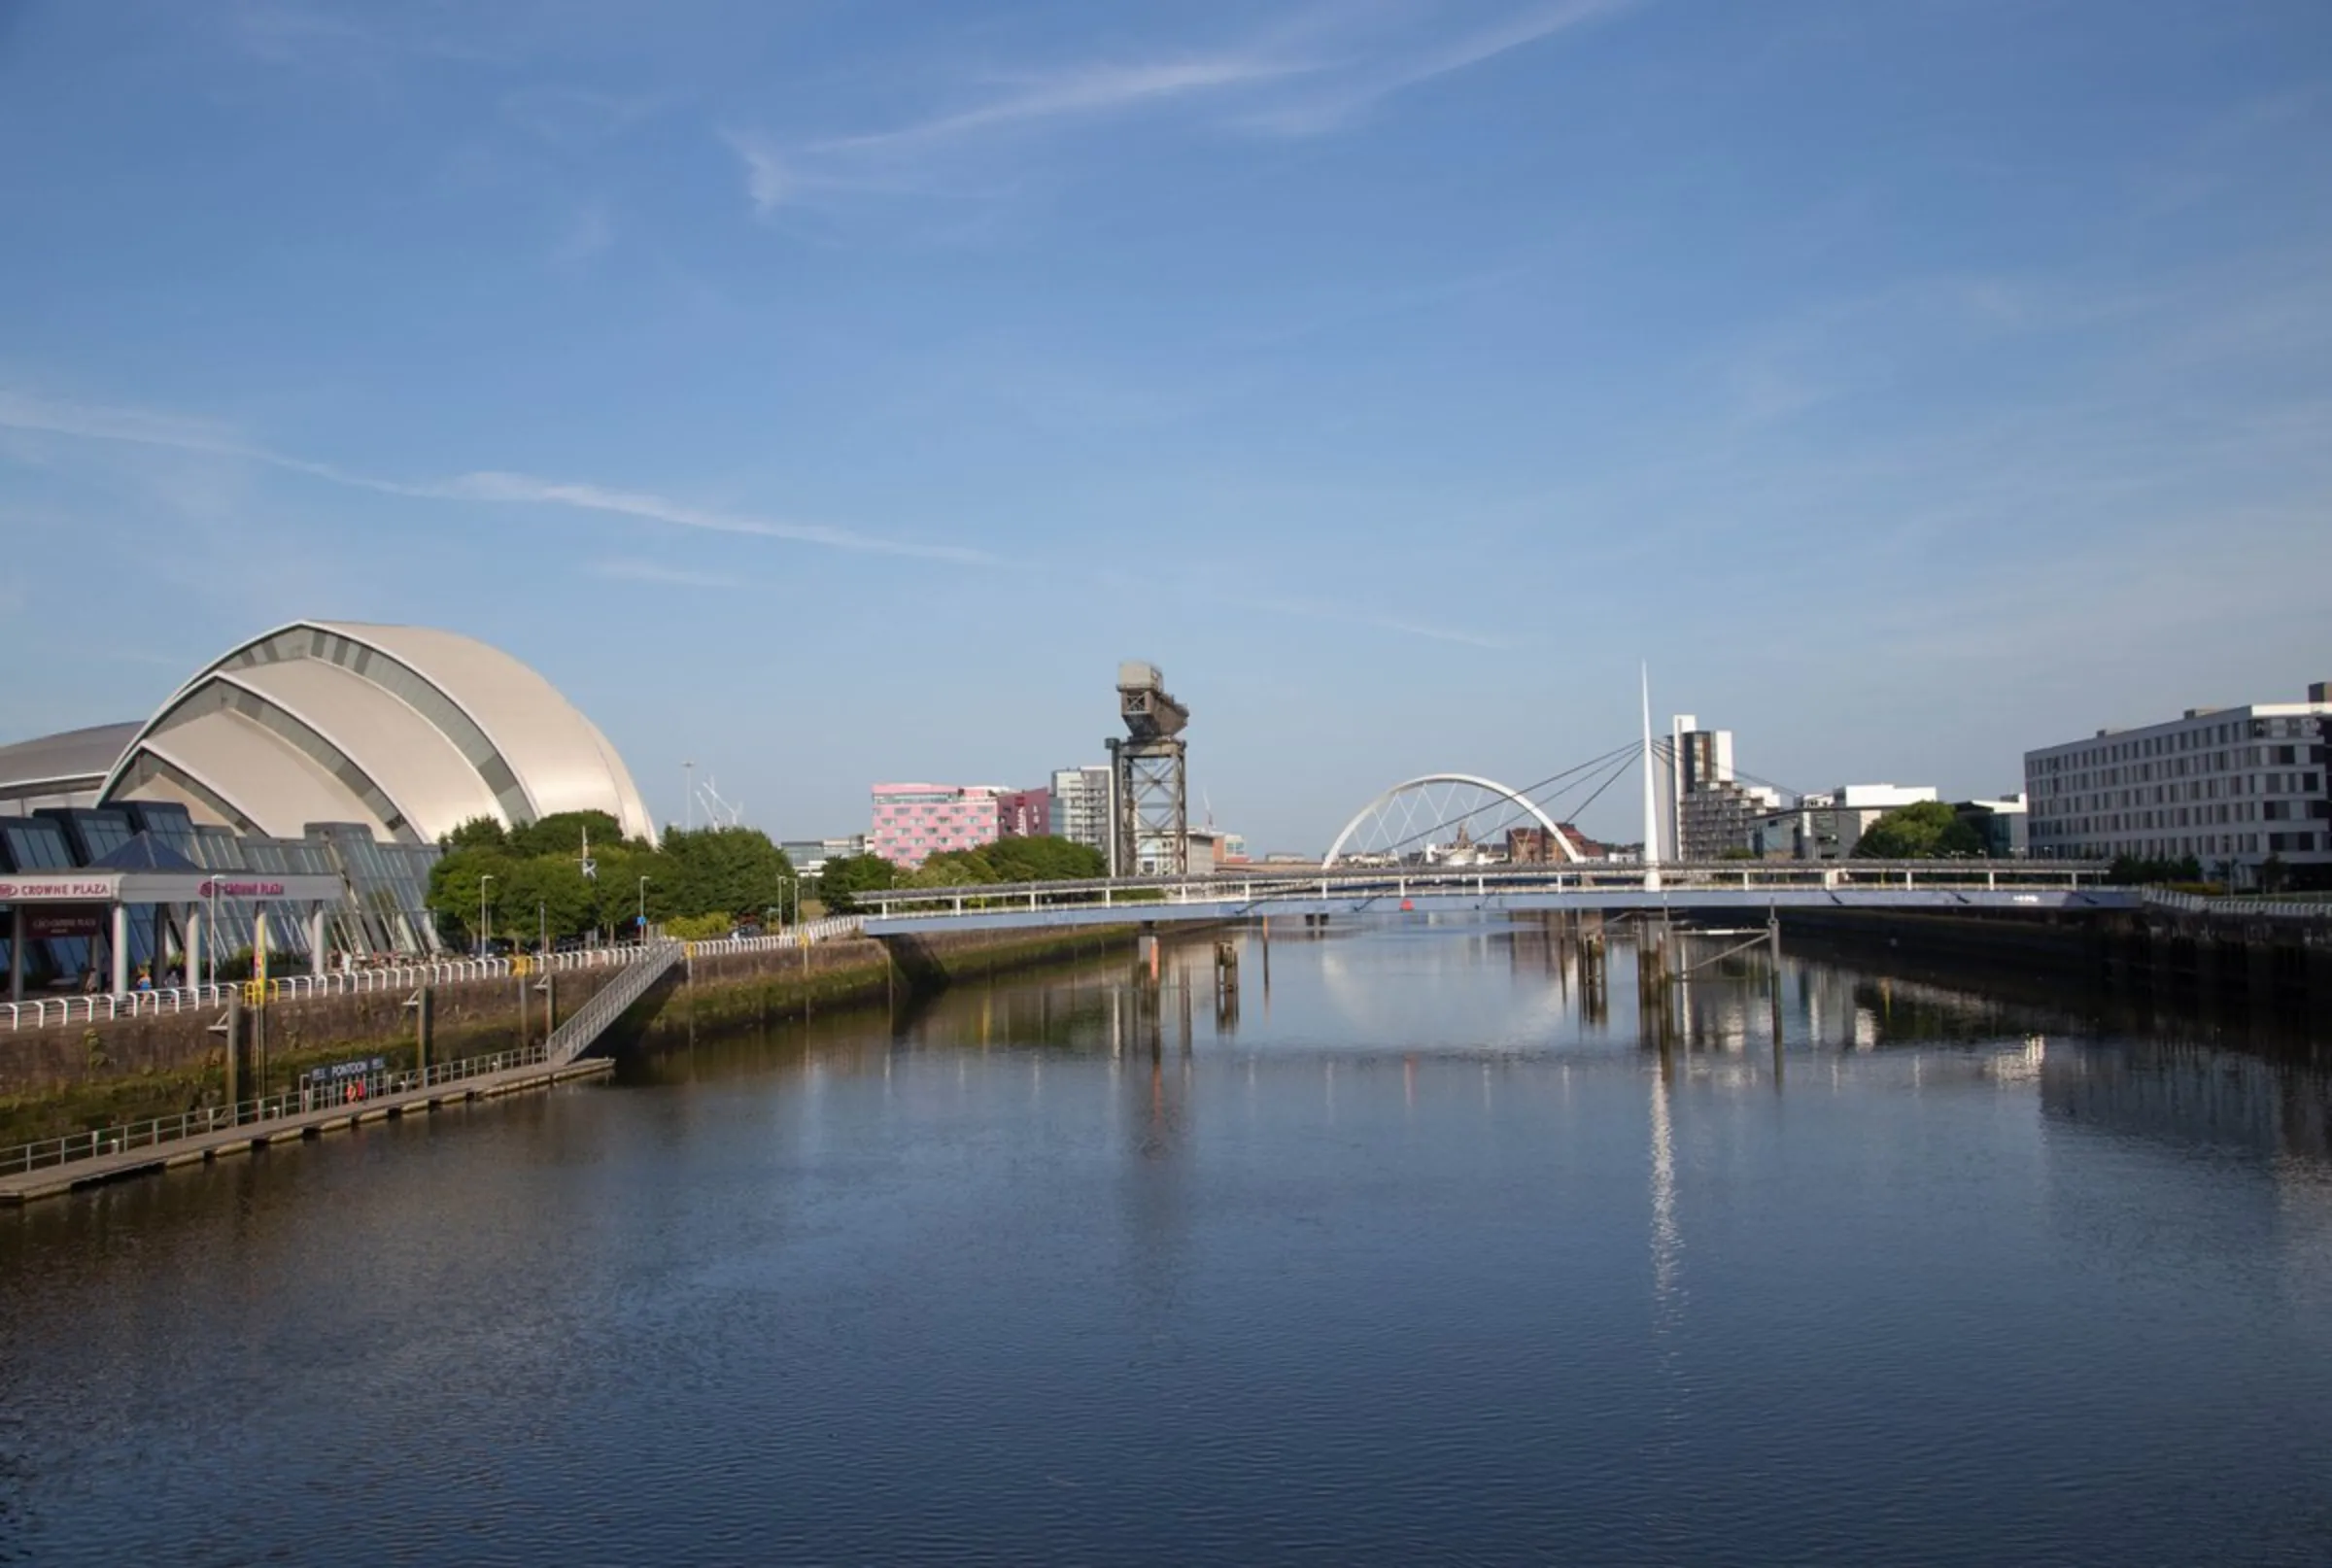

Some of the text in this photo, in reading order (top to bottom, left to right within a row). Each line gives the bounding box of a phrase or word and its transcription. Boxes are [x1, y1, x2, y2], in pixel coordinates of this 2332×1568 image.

[21, 883, 109, 896] CROWNE PLAZA
[331, 1061, 367, 1076] PONTOON
